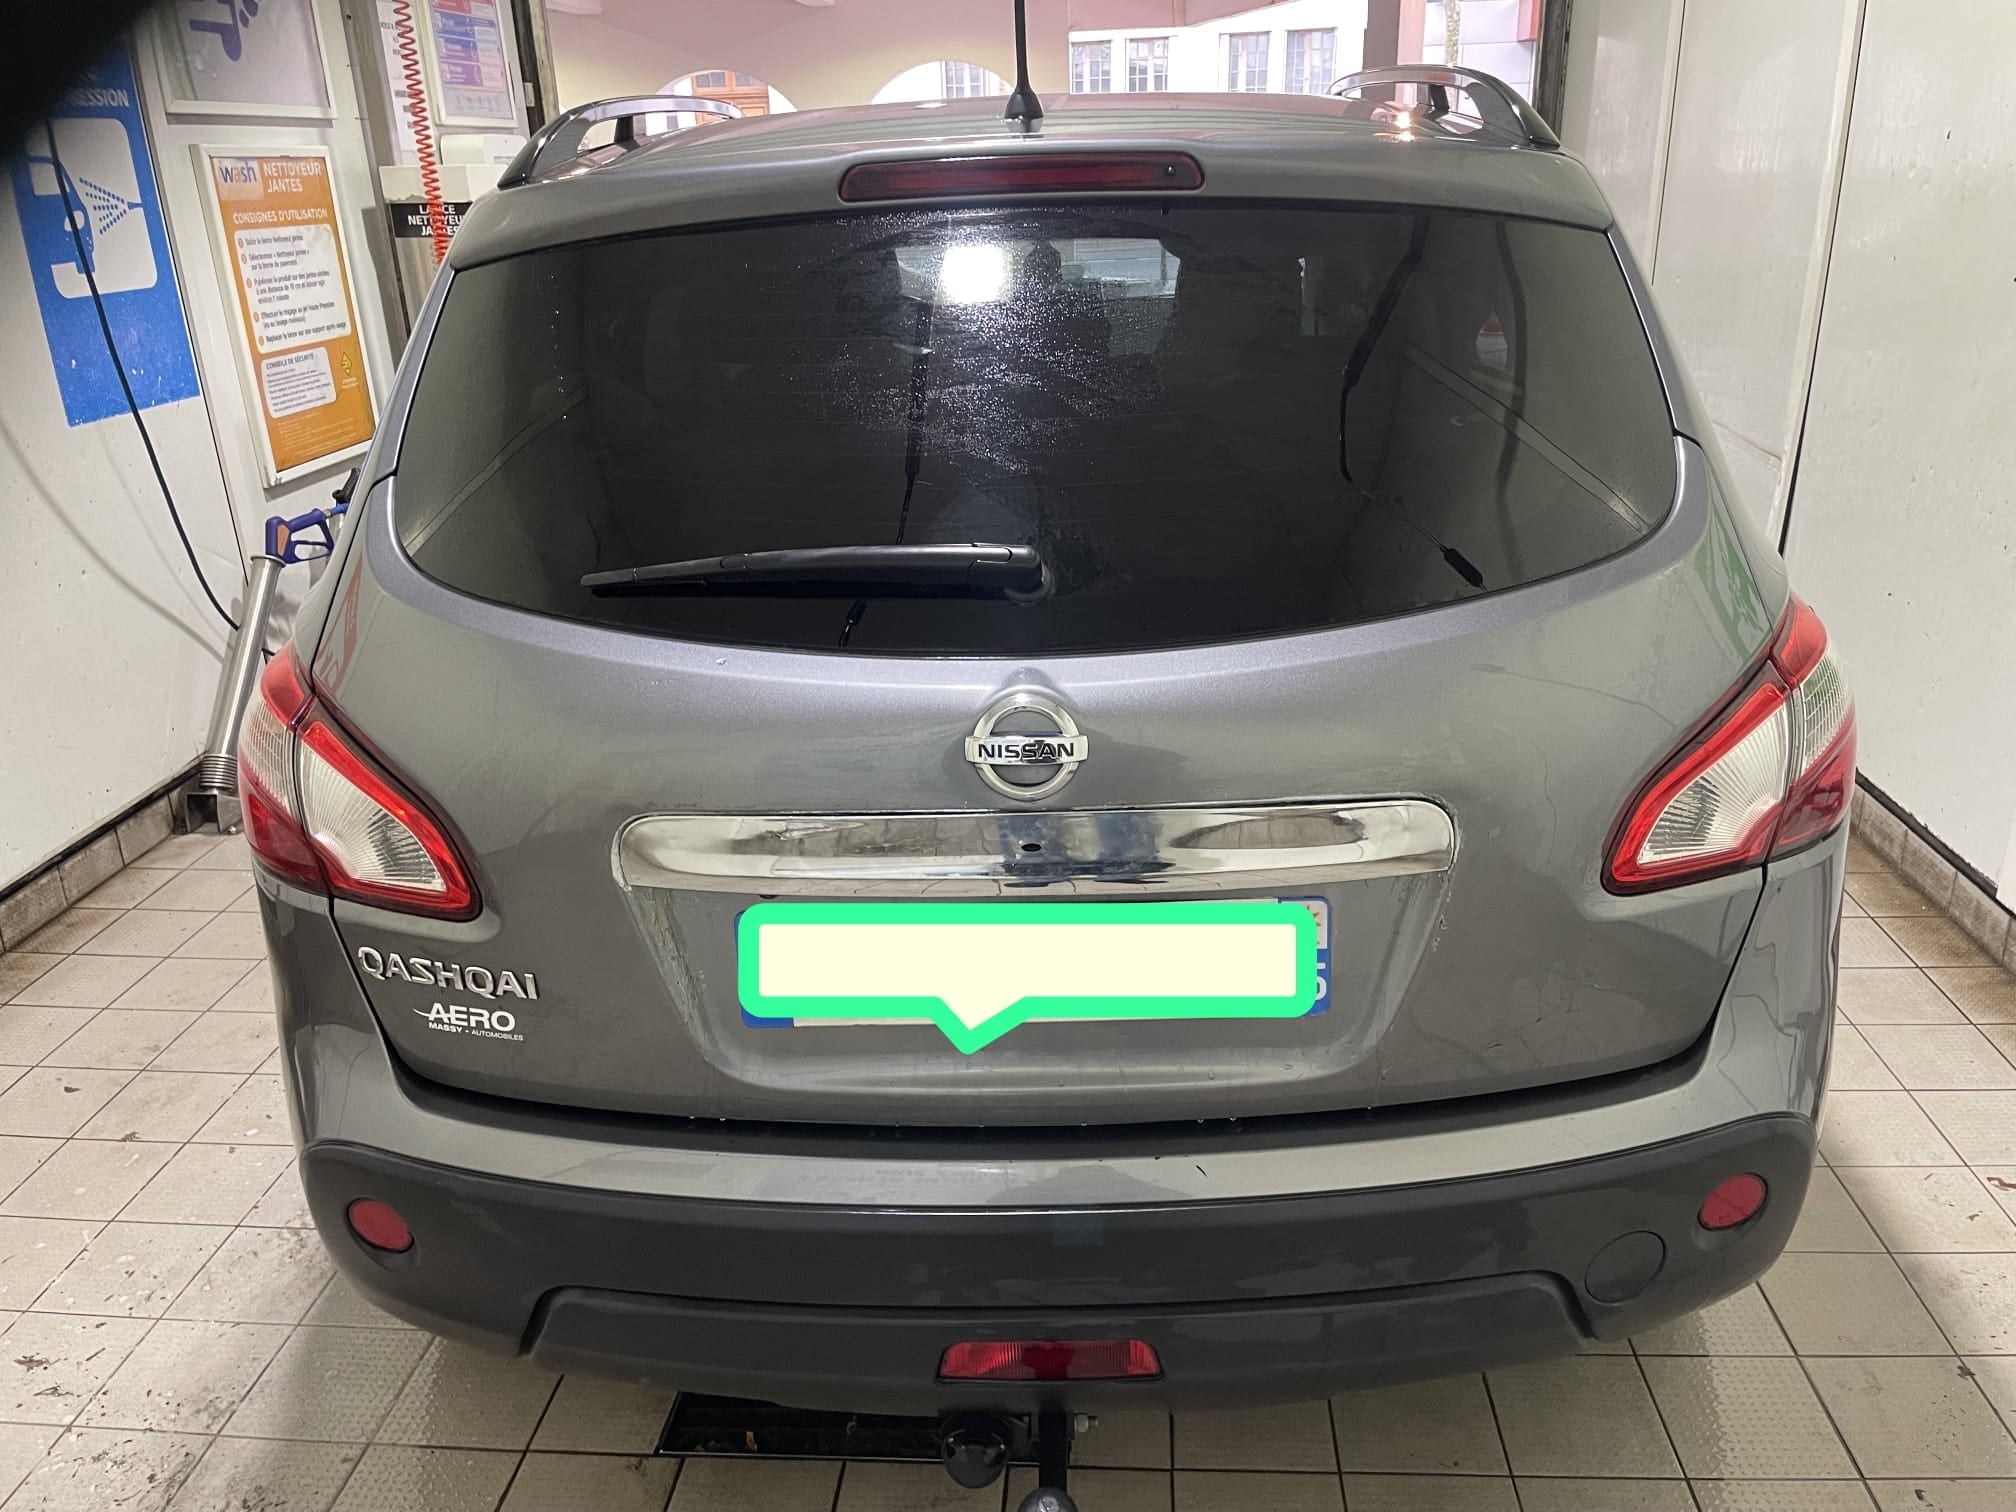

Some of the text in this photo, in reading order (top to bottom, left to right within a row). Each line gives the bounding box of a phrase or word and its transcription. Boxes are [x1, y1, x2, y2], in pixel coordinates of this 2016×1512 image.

[263, 161, 321, 176] NETTOYEUR
[267, 179, 303, 193] JANTES
[233, 208, 328, 224] CONSIGNES D'UTILISATION
[419, 204, 455, 214] LCE
[978, 743, 1074, 758] NISSAN
[358, 946, 539, 1000] QASHQAI
[427, 1002, 516, 1031] AERO
[428, 1021, 524, 1041] MASSY AUTOMOBILES
